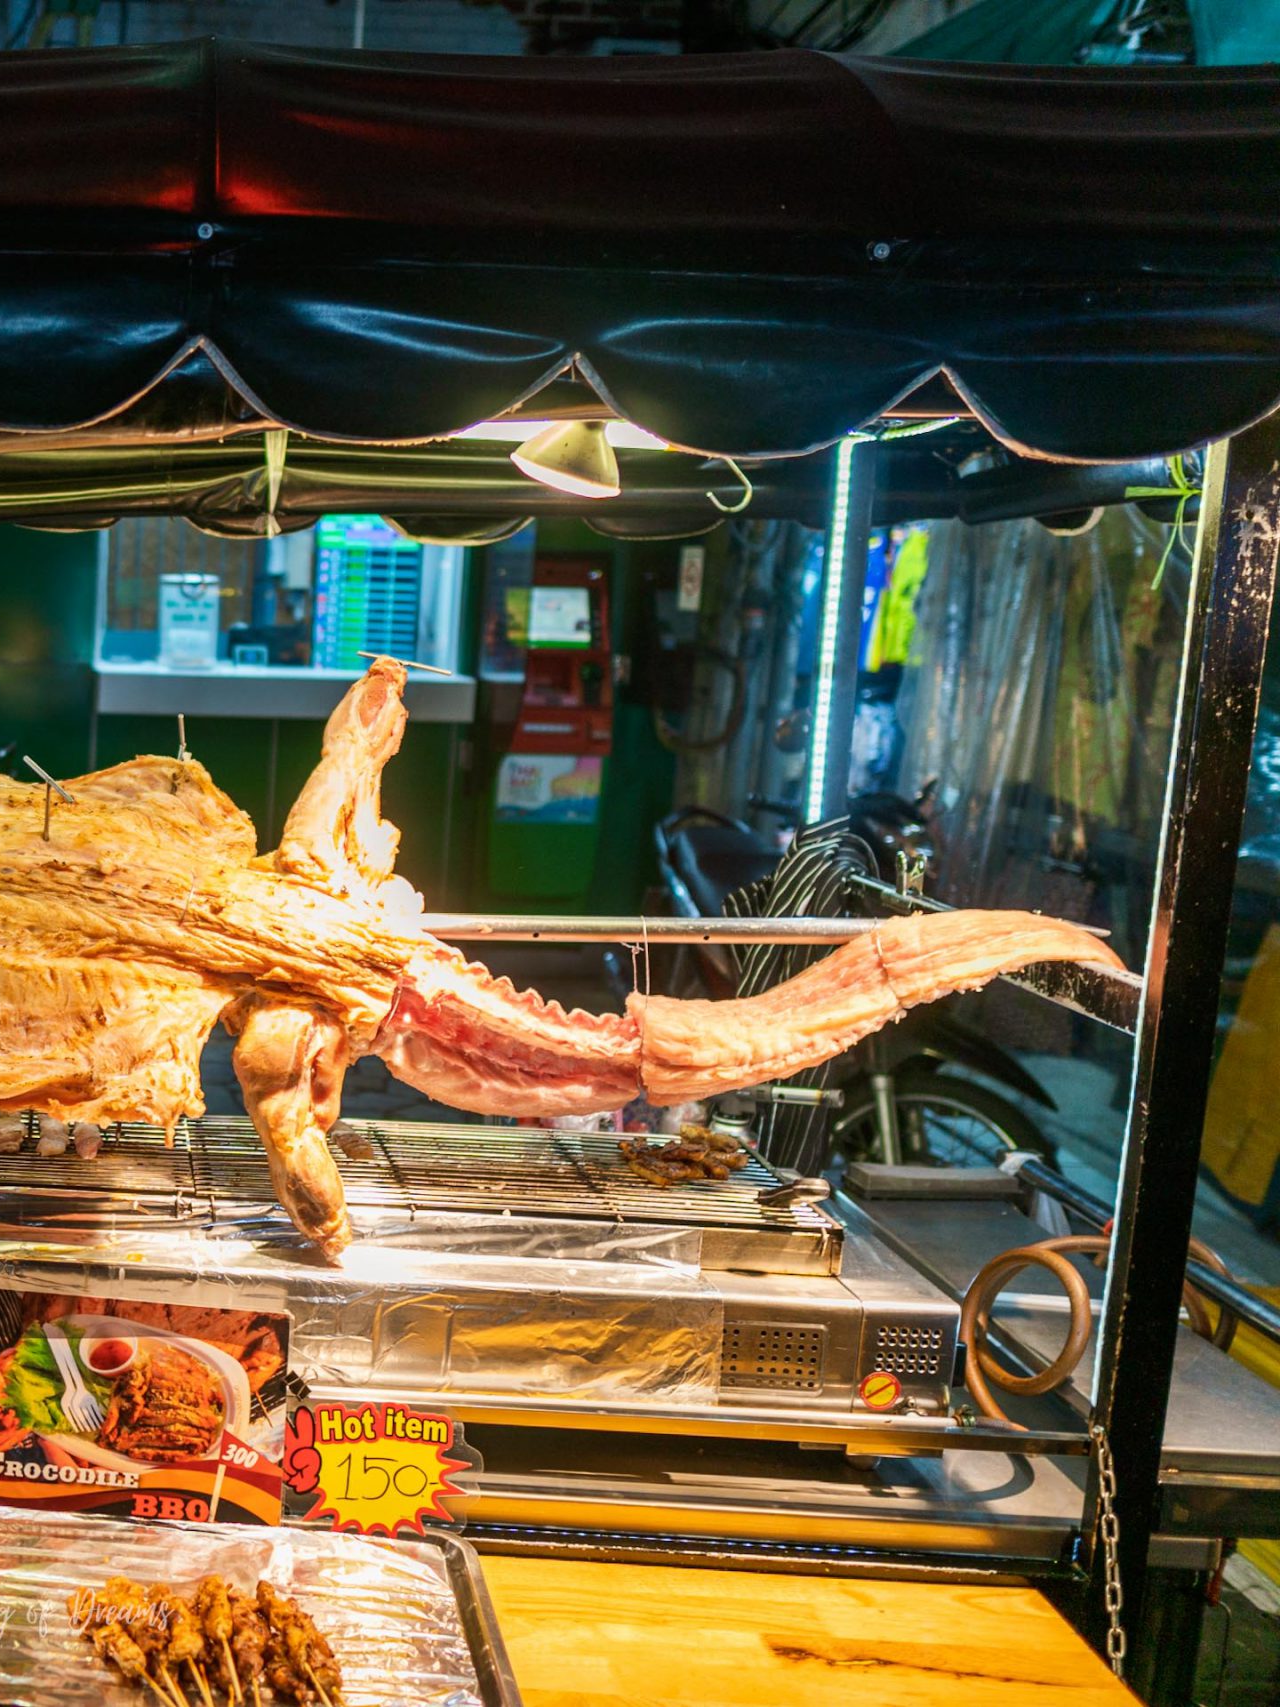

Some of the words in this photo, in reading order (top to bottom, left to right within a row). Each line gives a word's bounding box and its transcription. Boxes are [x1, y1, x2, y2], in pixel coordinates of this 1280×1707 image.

[320, 1408, 376, 1442] Hot
[384, 1407, 448, 1444] item
[222, 1443, 259, 1468] 300
